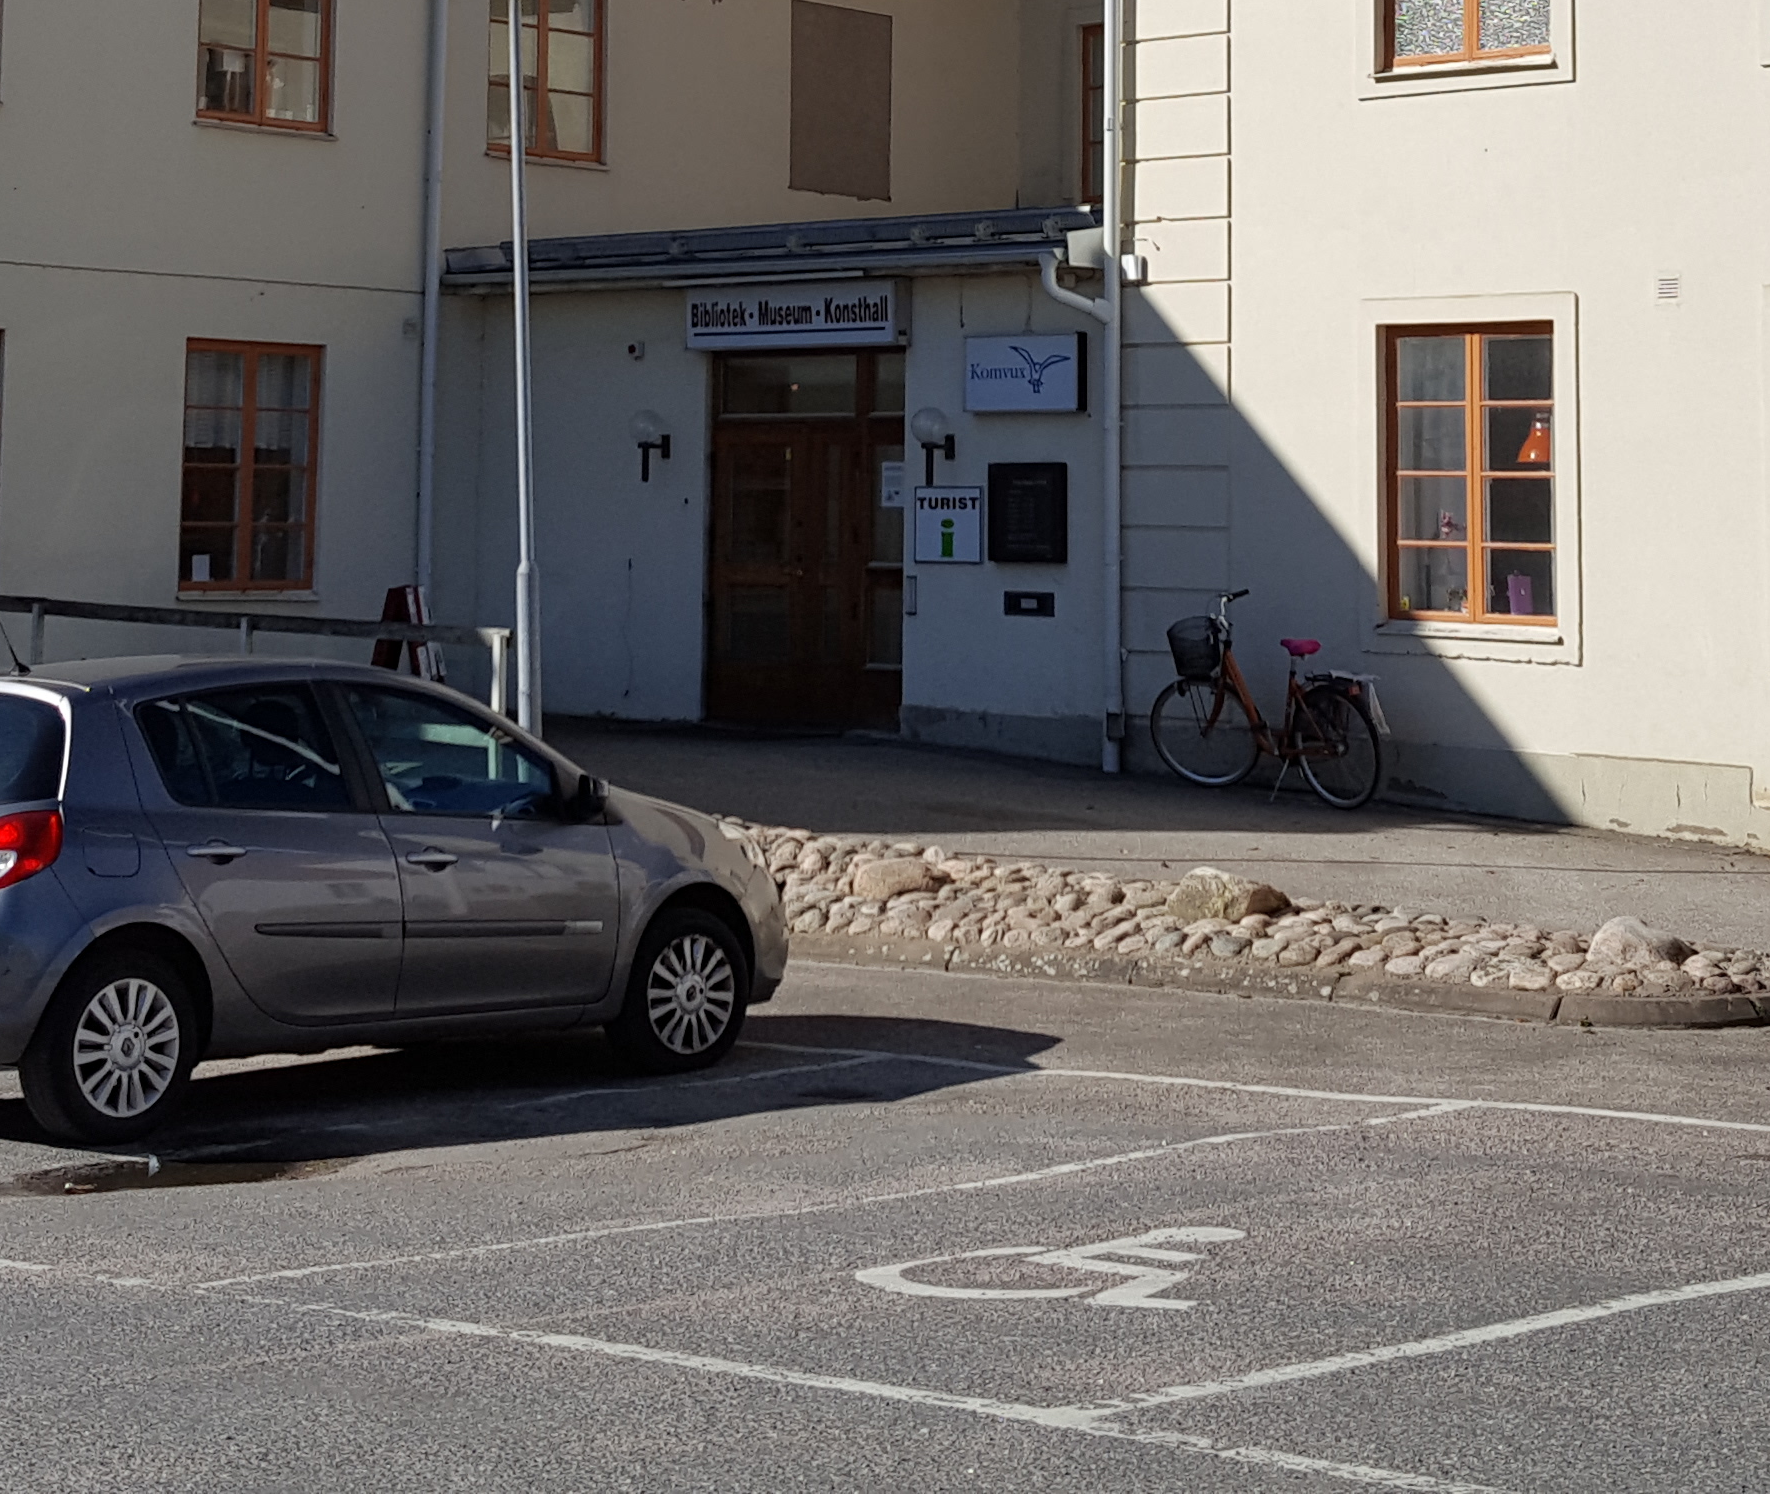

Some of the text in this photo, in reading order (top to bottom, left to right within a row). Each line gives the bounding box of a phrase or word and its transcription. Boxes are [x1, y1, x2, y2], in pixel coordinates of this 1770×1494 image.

[690, 295, 889, 328] Bibliotek Museum Konsthall
[969, 363, 1026, 382] Komvux
[917, 495, 979, 511] TURIST
